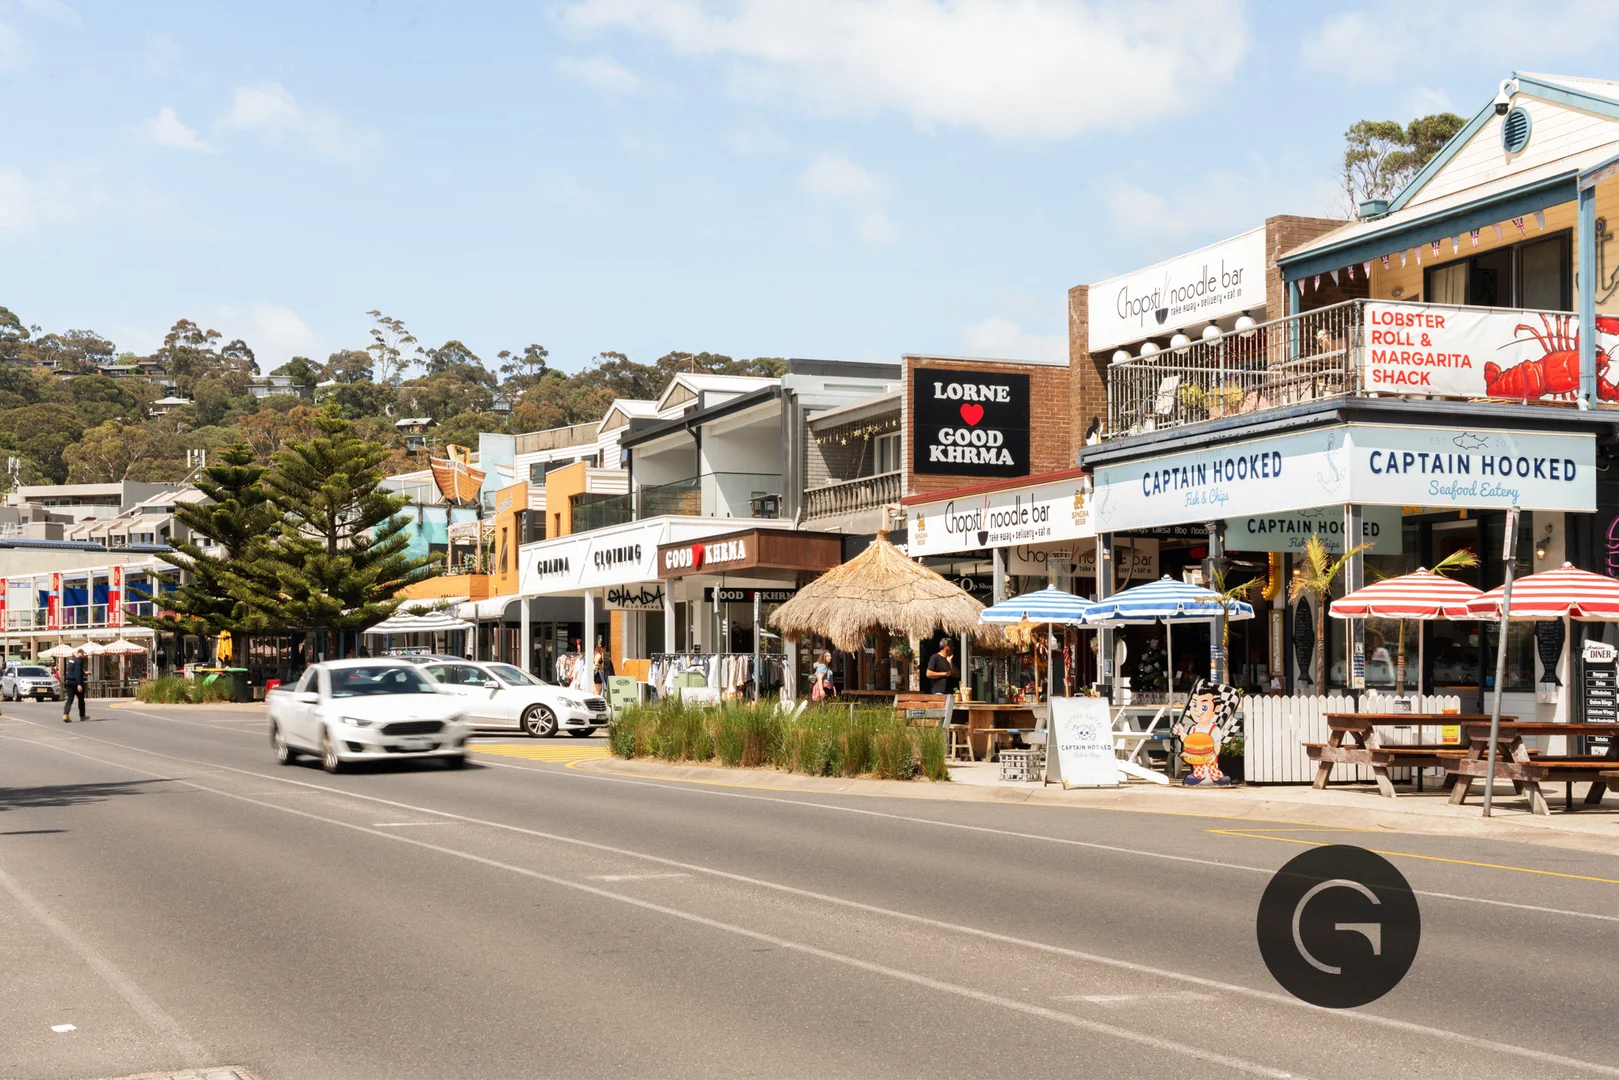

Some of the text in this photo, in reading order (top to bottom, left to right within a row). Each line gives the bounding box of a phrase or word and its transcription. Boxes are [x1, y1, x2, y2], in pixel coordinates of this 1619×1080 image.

[1170, 265, 1217, 304] noodle
[1222, 259, 1244, 288] bar
[1371, 311, 1445, 330] LOBSTER
[1371, 331, 1432, 347] ROLL &
[1371, 350, 1473, 369] MARGARITA
[1372, 369, 1432, 386] SHACK
[933, 382, 1011, 403] LORNE
[938, 428, 1004, 447] GOOD
[929, 445, 1015, 466] KHRMA
[1142, 463, 1207, 497] CAPTAIN
[1213, 450, 1282, 483] HOOKED
[1369, 450, 1577, 482] CAPTAIN HOOKED
[1184, 491, 1200, 508] Fish
[1201, 490, 1207, 504] &
[1208, 487, 1229, 507] Chips
[1428, 480, 1520, 505] Seafood Eatery
[990, 495, 1029, 529] noodle
[1031, 493, 1051, 523] bar
[1071, 510, 1090, 519] SINGHA
[1074, 518, 1087, 526] BEER
[1247, 518, 1380, 537] CAPTAIN HOED
[594, 544, 642, 566] CLOTHING
[665, 540, 746, 570] GOOD KHRMA
[537, 556, 570, 575] GHANDA
[960, 577, 978, 592] Op
[762, 592, 796, 601] KHRM
[1590, 650, 1611, 659] DINER
